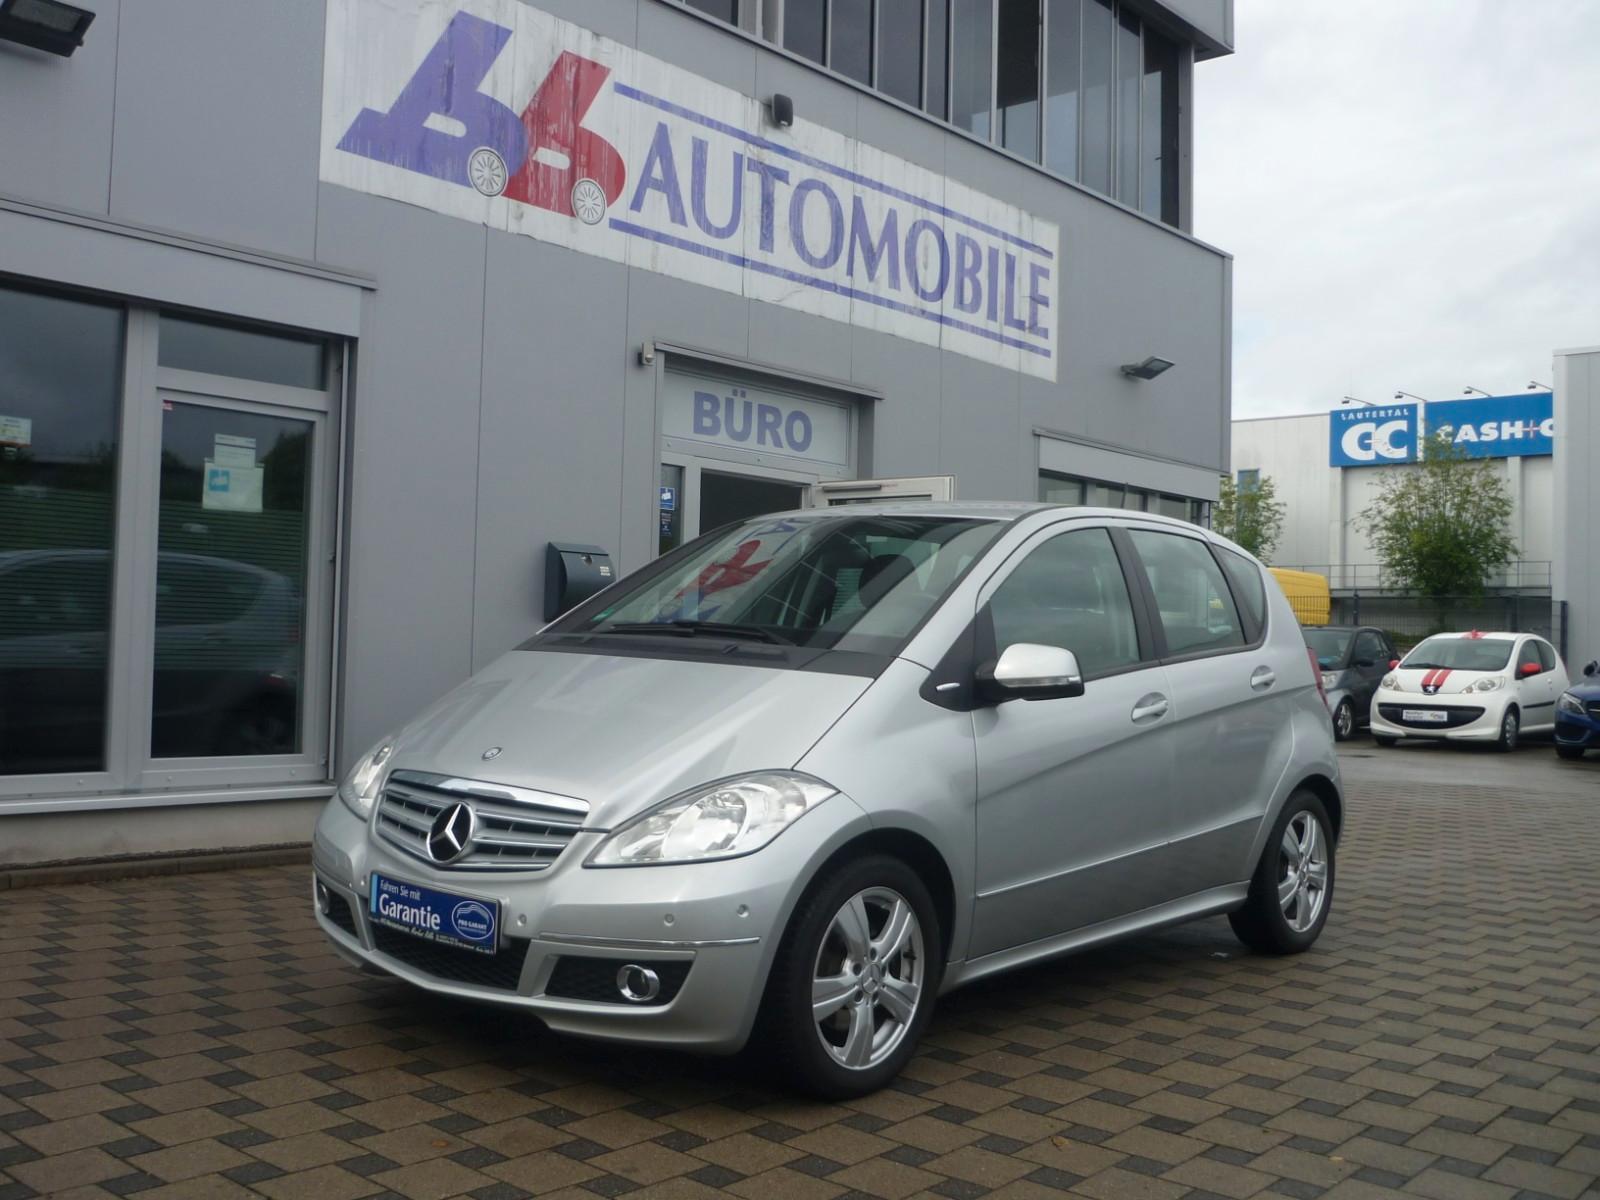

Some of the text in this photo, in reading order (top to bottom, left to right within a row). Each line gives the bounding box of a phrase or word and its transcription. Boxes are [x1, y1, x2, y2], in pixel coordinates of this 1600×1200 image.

[629, 121, 1051, 340] AUTOMOBILE
[693, 388, 812, 452] BÜRO
[1341, 408, 1409, 421] LAUTERTAL
[379, 893, 441, 931] Garantie
